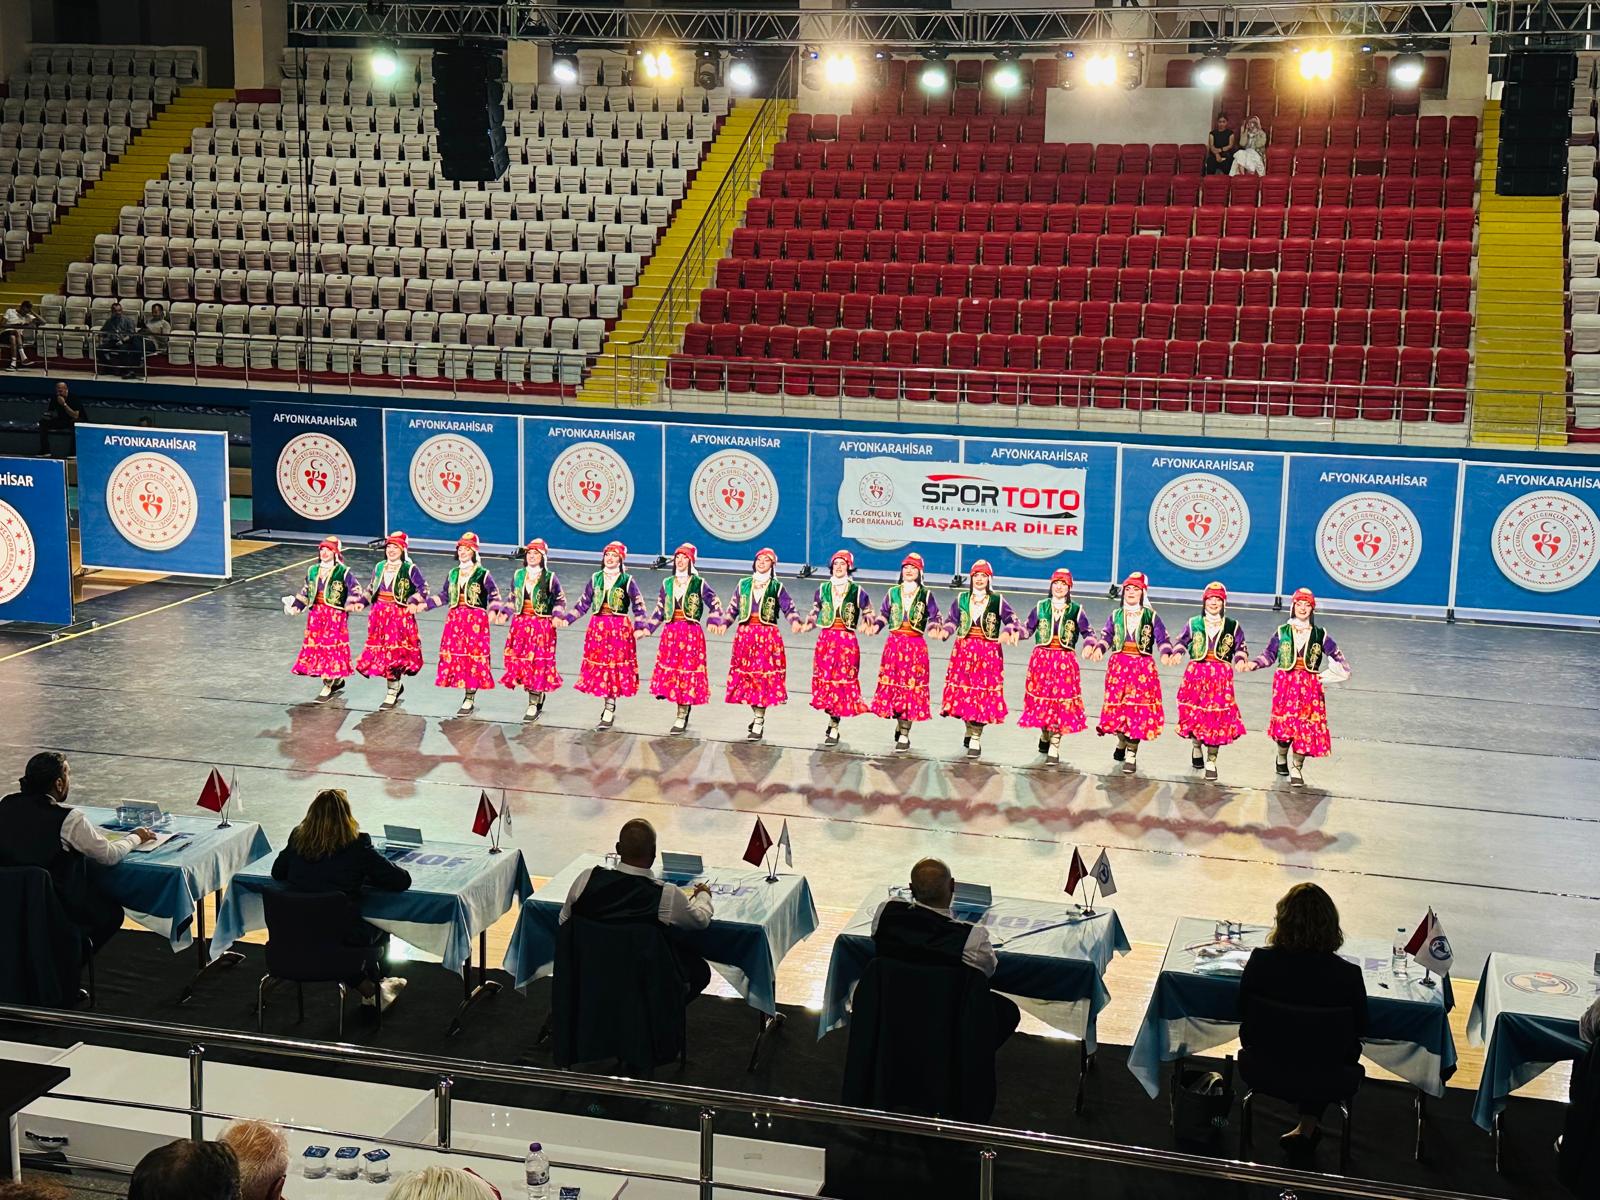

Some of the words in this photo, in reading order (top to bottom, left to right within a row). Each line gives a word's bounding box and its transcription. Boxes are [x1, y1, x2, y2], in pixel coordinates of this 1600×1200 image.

[272, 413, 358, 427] AFYONKARAHİSAR
[408, 418, 494, 433] AFYONKARAHİSAR
[548, 427, 636, 441] AFYONKARAHİSAR
[690, 434, 781, 448] AFYONKARAHİSAR
[104, 435, 197, 451] AFYONKARAHİSAR
[839, 441, 933, 455] AFYONKARAHİSAR
[991, 448, 1089, 462] AFYONKARAHİSAR
[1151, 457, 1254, 472] AFYONKARAHİSAR
[1319, 471, 1428, 487] AFYONKARAHİSAR
[863, 509, 892, 518] GENÇLİK
[847, 517, 866, 525] SPOR
[867, 517, 904, 527] BAKANLIĞI
[913, 516, 1017, 533] BAŞARILAR
[1023, 520, 1078, 536] DİLER
